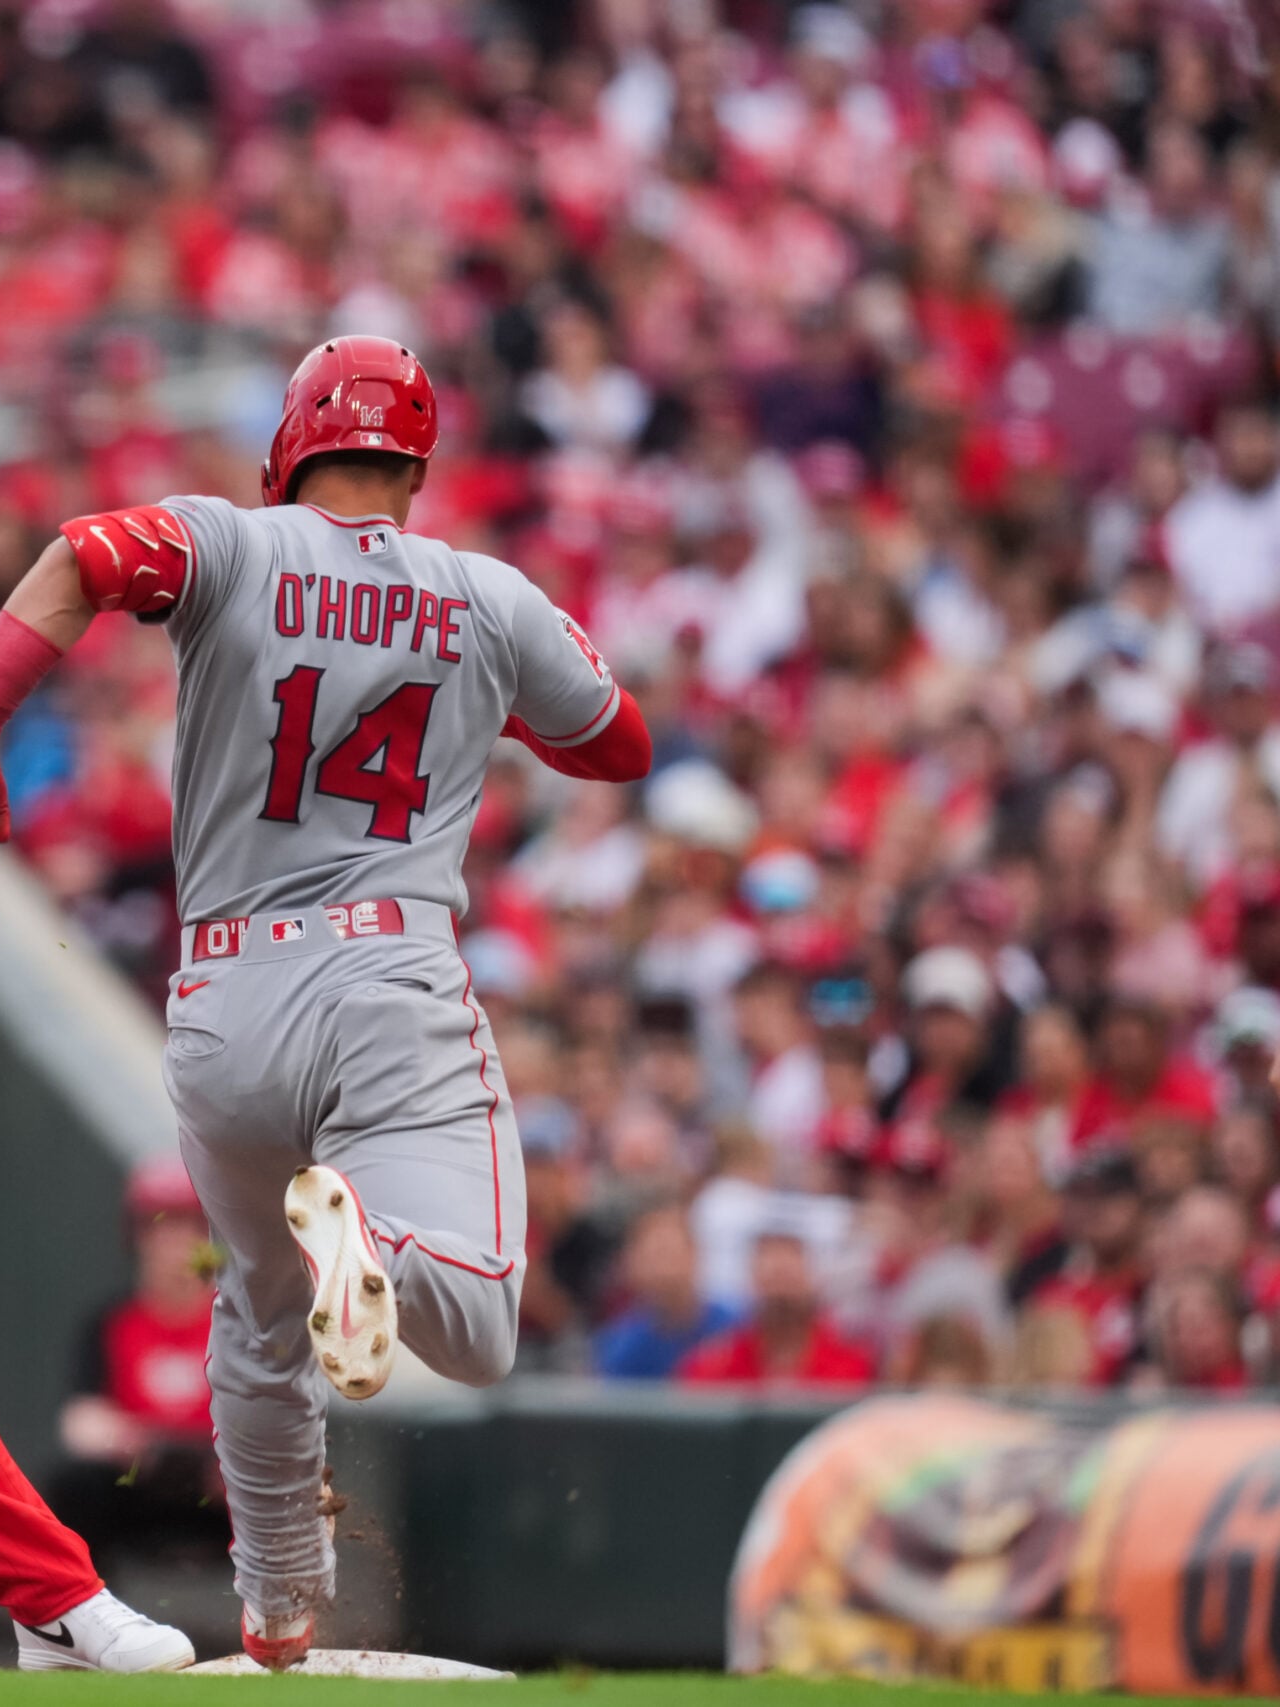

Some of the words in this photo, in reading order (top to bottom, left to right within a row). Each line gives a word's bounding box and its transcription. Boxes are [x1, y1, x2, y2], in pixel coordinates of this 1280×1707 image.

[360, 405, 384, 427] 14
[275, 573, 469, 664] O'HOPPE
[257, 664, 442, 844] 14
